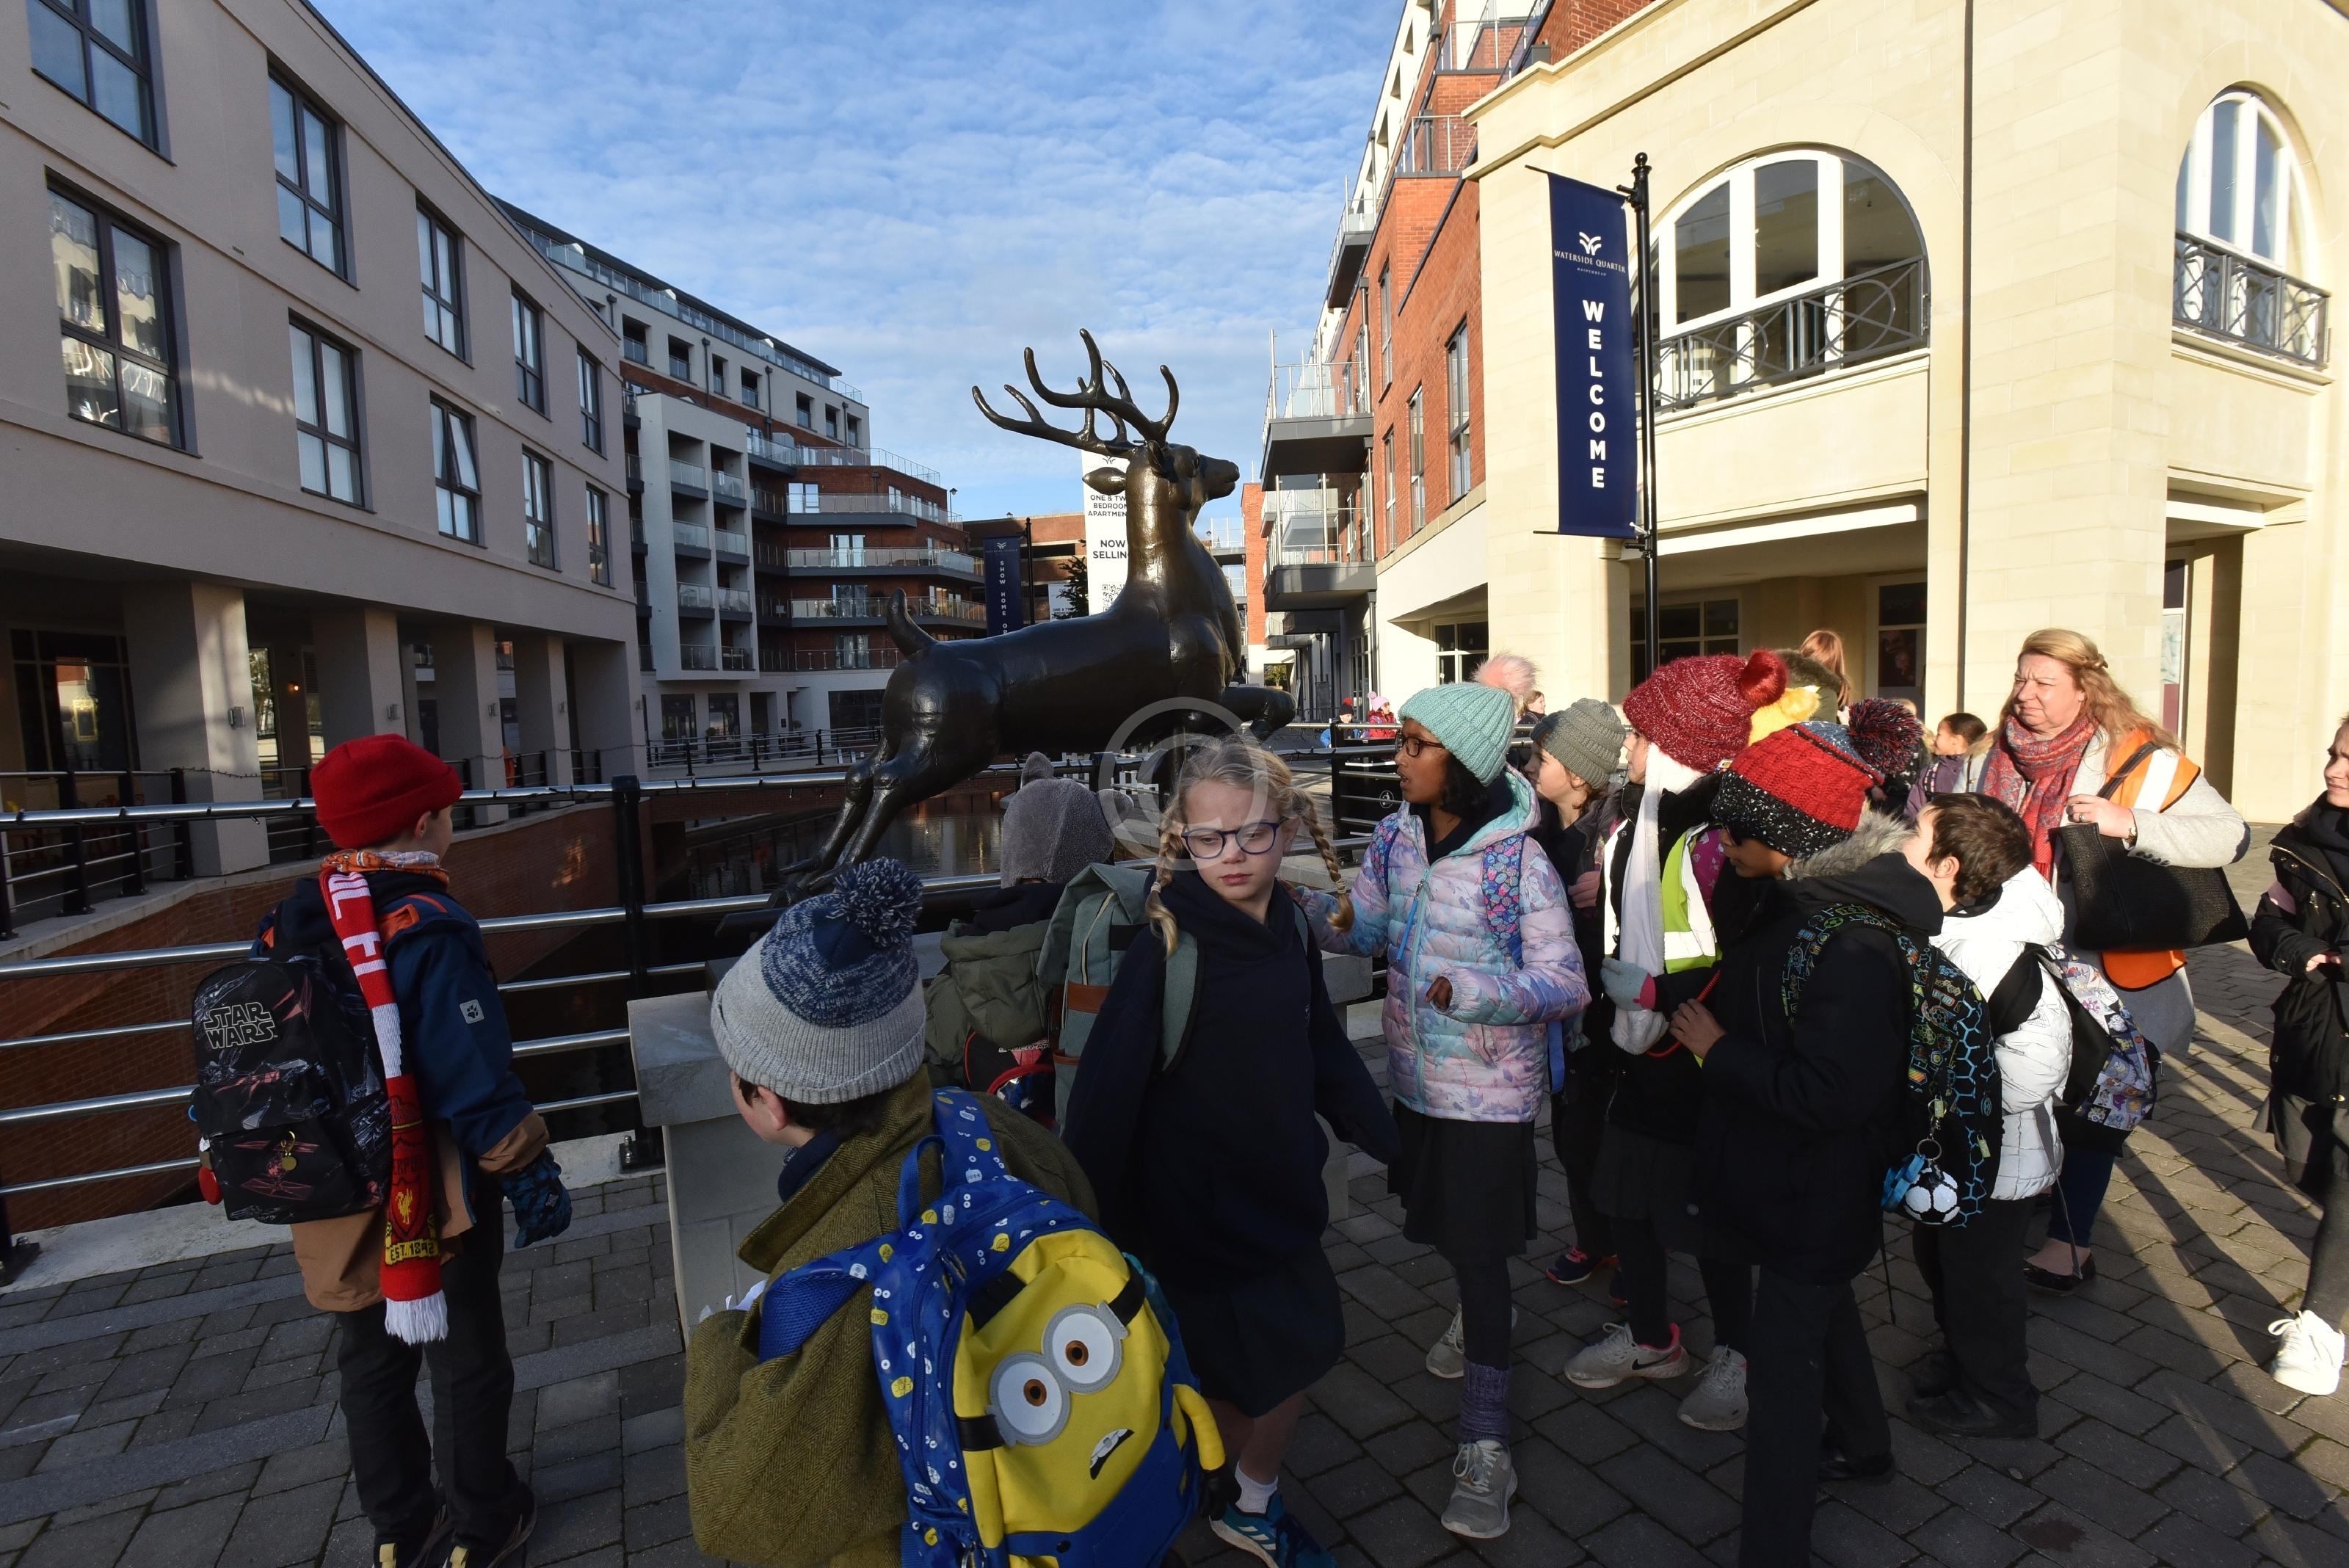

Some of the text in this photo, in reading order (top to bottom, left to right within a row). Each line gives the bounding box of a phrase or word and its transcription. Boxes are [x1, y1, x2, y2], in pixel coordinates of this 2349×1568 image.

[1554, 250, 1626, 274] WATERSIDE QUARTER
[1582, 300, 1606, 488] WELCOME
[1092, 551, 1128, 559] SELLIN
[1100, 540, 1125, 548] NOW
[203, 1002, 272, 1029] STAR
[206, 1020, 275, 1049] WARS
